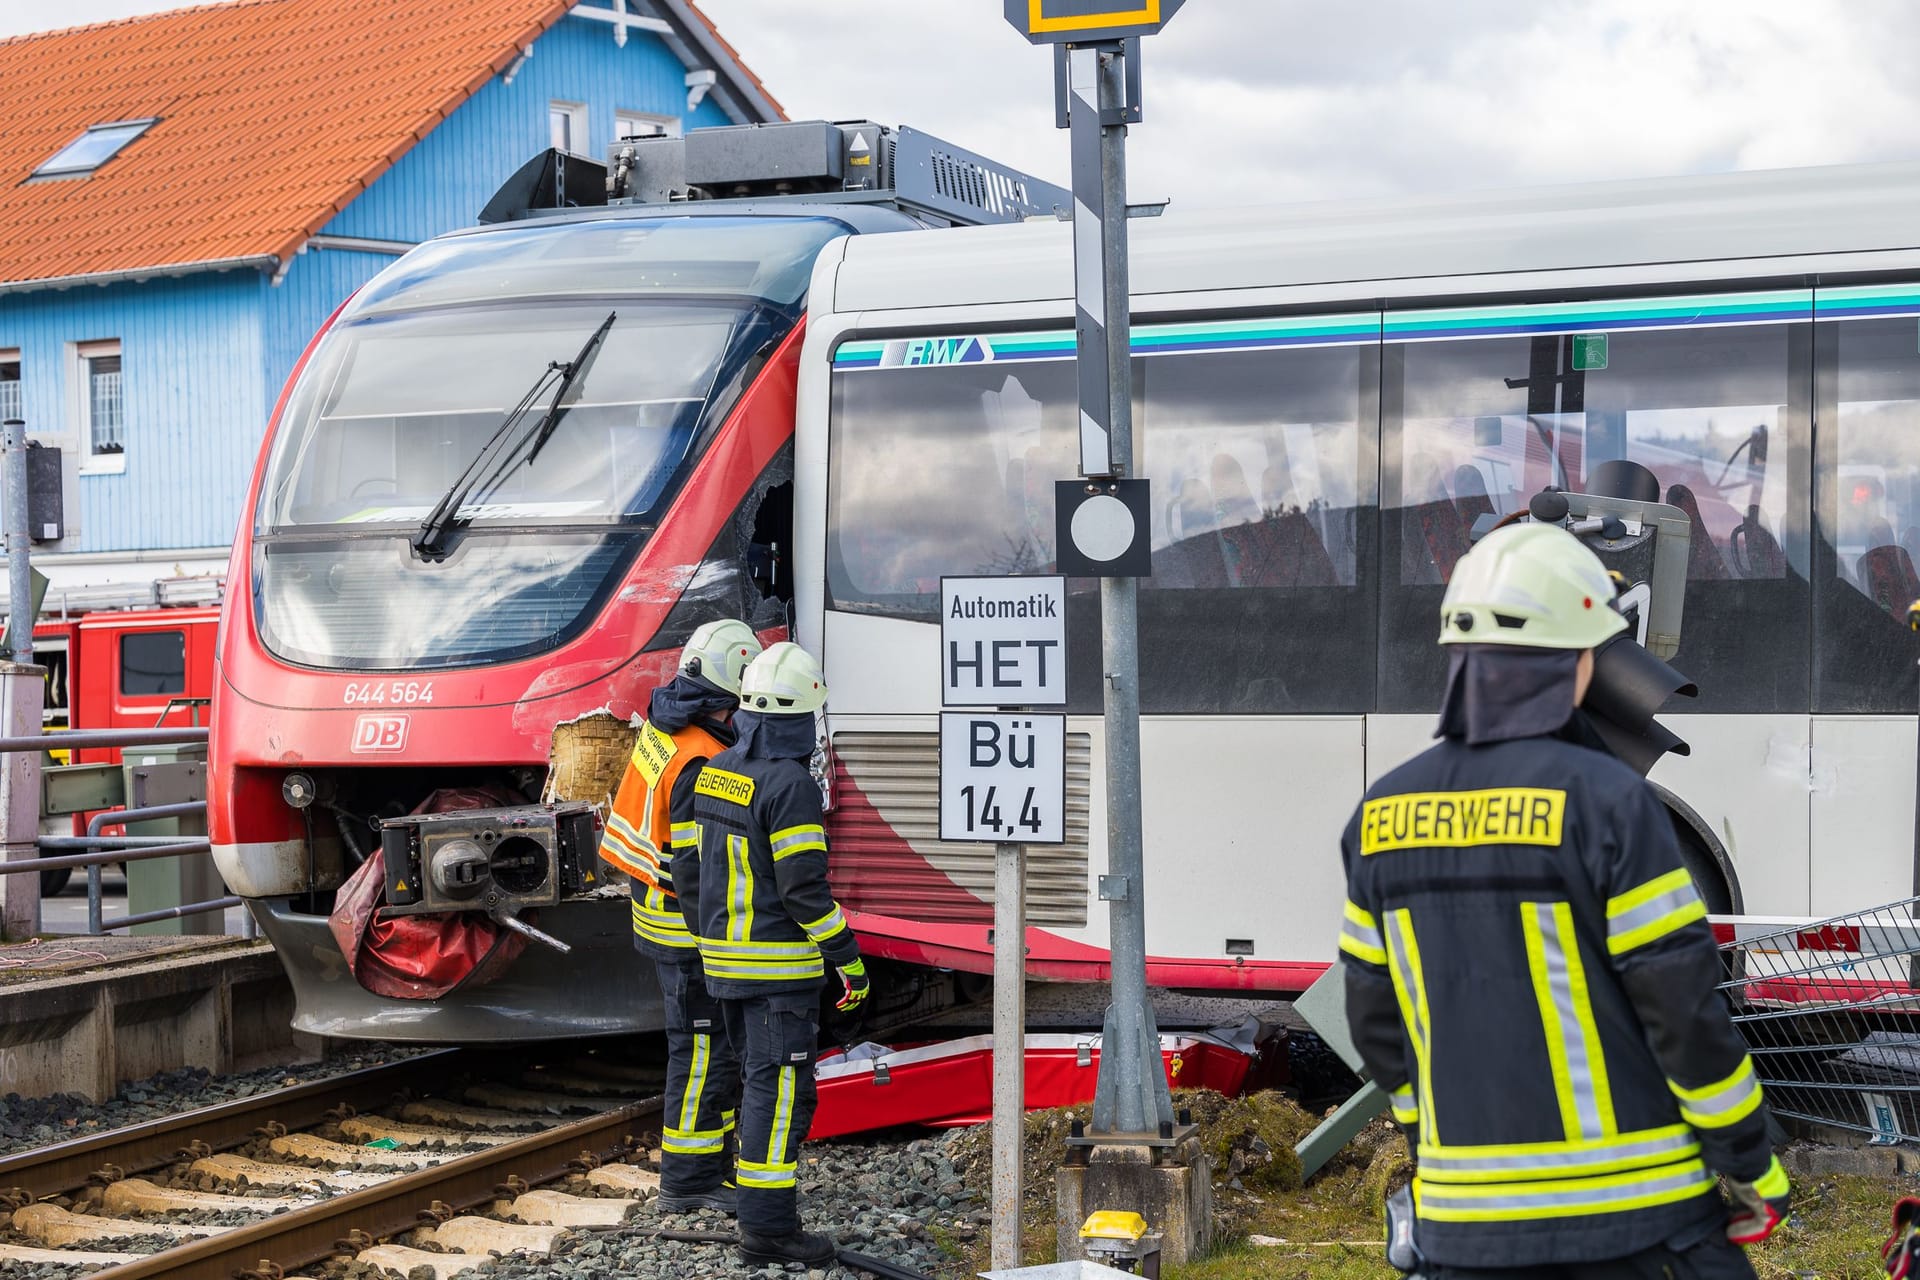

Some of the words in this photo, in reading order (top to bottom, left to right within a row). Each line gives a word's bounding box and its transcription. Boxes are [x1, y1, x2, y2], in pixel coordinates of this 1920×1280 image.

[950, 593, 1057, 619] Automatik
[950, 640, 1058, 688] HET
[343, 682, 385, 704] 644
[390, 681, 433, 704] 564
[357, 718, 405, 748] DB
[969, 720, 1035, 768] Bü
[697, 771, 751, 800] FEUERWEHR
[960, 785, 1042, 837] 14,4
[1367, 796, 1551, 847] FEUERWEHR
